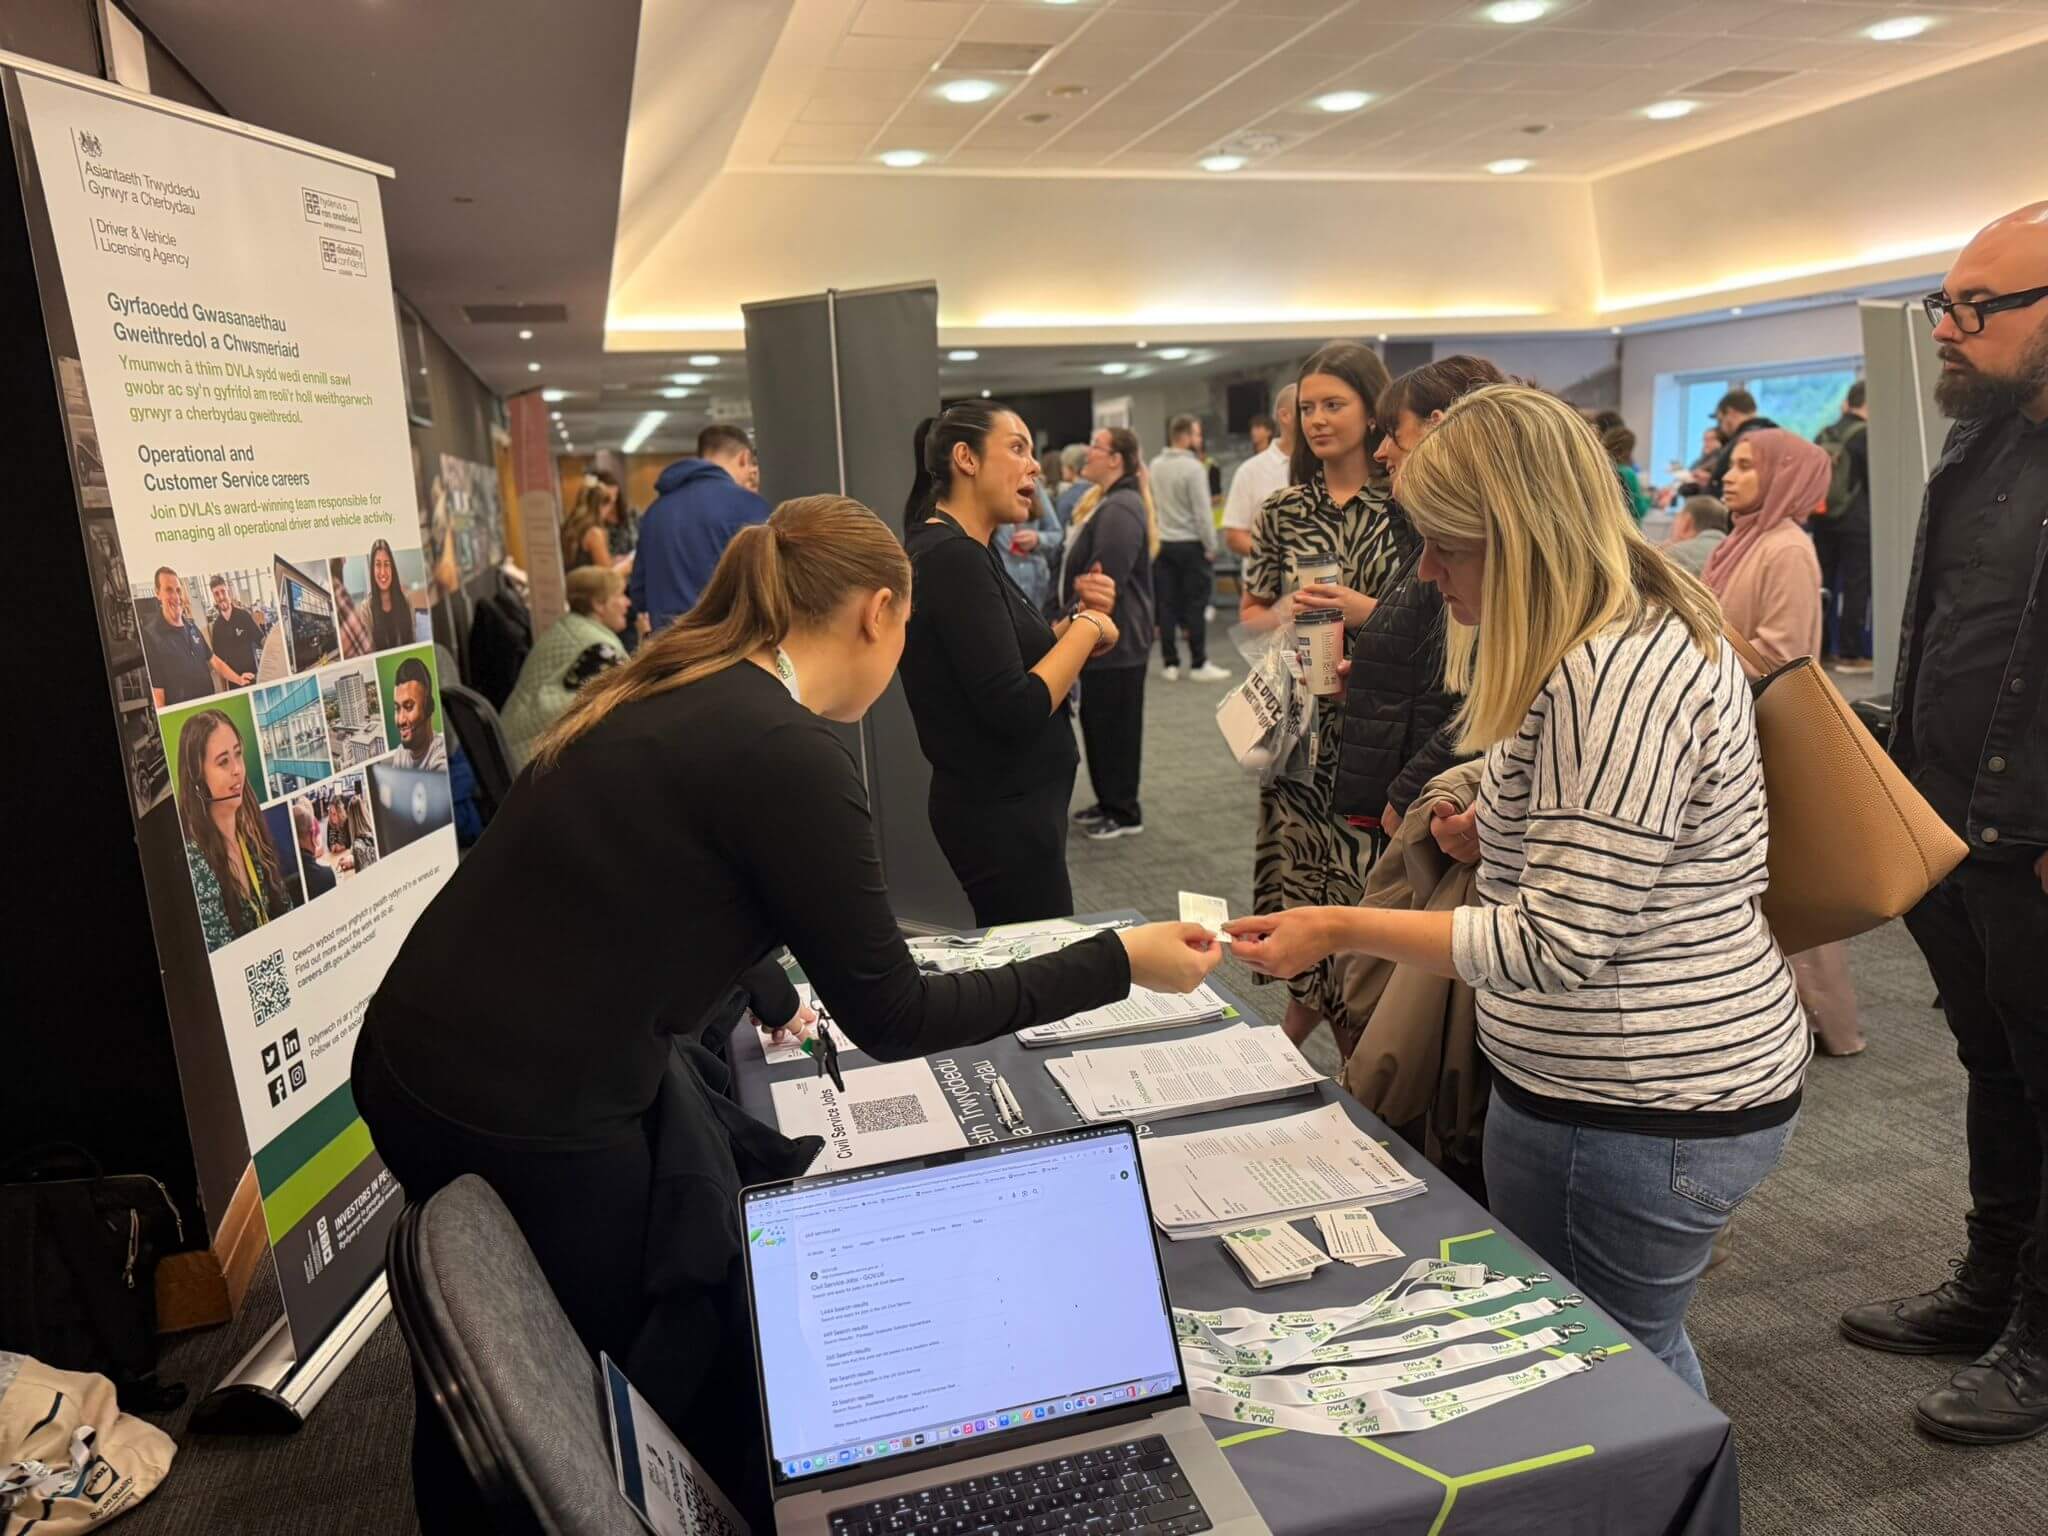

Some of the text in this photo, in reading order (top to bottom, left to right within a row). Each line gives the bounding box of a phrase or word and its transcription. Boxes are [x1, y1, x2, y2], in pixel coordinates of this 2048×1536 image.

[85, 161, 200, 200] Asiantaeth Trwyddedu
[88, 180, 196, 216] Gyrwyr a Cherbydau
[96, 218, 177, 247] Driver & Vehicle
[100, 237, 190, 269] Licensing Agency
[107, 292, 286, 332] Gyrfaoedd Gwasanaethau
[113, 322, 300, 358] Gweithredol a Chwsmeriaid
[118, 354, 183, 374] Ymunwch
[224, 363, 255, 379] DVLA
[256, 367, 278, 382] sydd
[278, 369, 301, 383] wedi
[302, 371, 328, 384] ennill
[329, 374, 352, 386] sawl
[124, 380, 373, 408] gwobr ac sy'n gyfrifol am reoli'r holl weithgarwch
[129, 405, 303, 425] gyrwyr a cherbydau gweithredol.
[138, 444, 254, 467] Operational and
[144, 471, 310, 492] Customer Service careers
[150, 493, 382, 520] Join DVLA's award-winning team responsible for
[154, 511, 396, 543] managing all operational driver and vehicle activity.
[315, 930, 335, 948] wybod
[294, 959, 310, 975] Find
[310, 953, 322, 966] out
[322, 945, 336, 958] more
[308, 1022, 336, 1047] Dilynwch
[310, 1040, 331, 1060] Follow
[935, 1058, 985, 1123] Trwyddedu
[820, 1088, 853, 1159] Civil Service Jobs
[334, 1179, 379, 1231] INVESTORS IN
[824, 1280, 844, 1288] Service
[1402, 1329, 1423, 1342] DVLA
[1236, 1350, 1257, 1359] DVLA
[1403, 1360, 1425, 1368] DVLA
[1308, 1369, 1331, 1379] DVLA
[1251, 1413, 1274, 1424] DVLA
[1327, 1403, 1349, 1411] DVLA
[1356, 1423, 1380, 1433] DVLA
